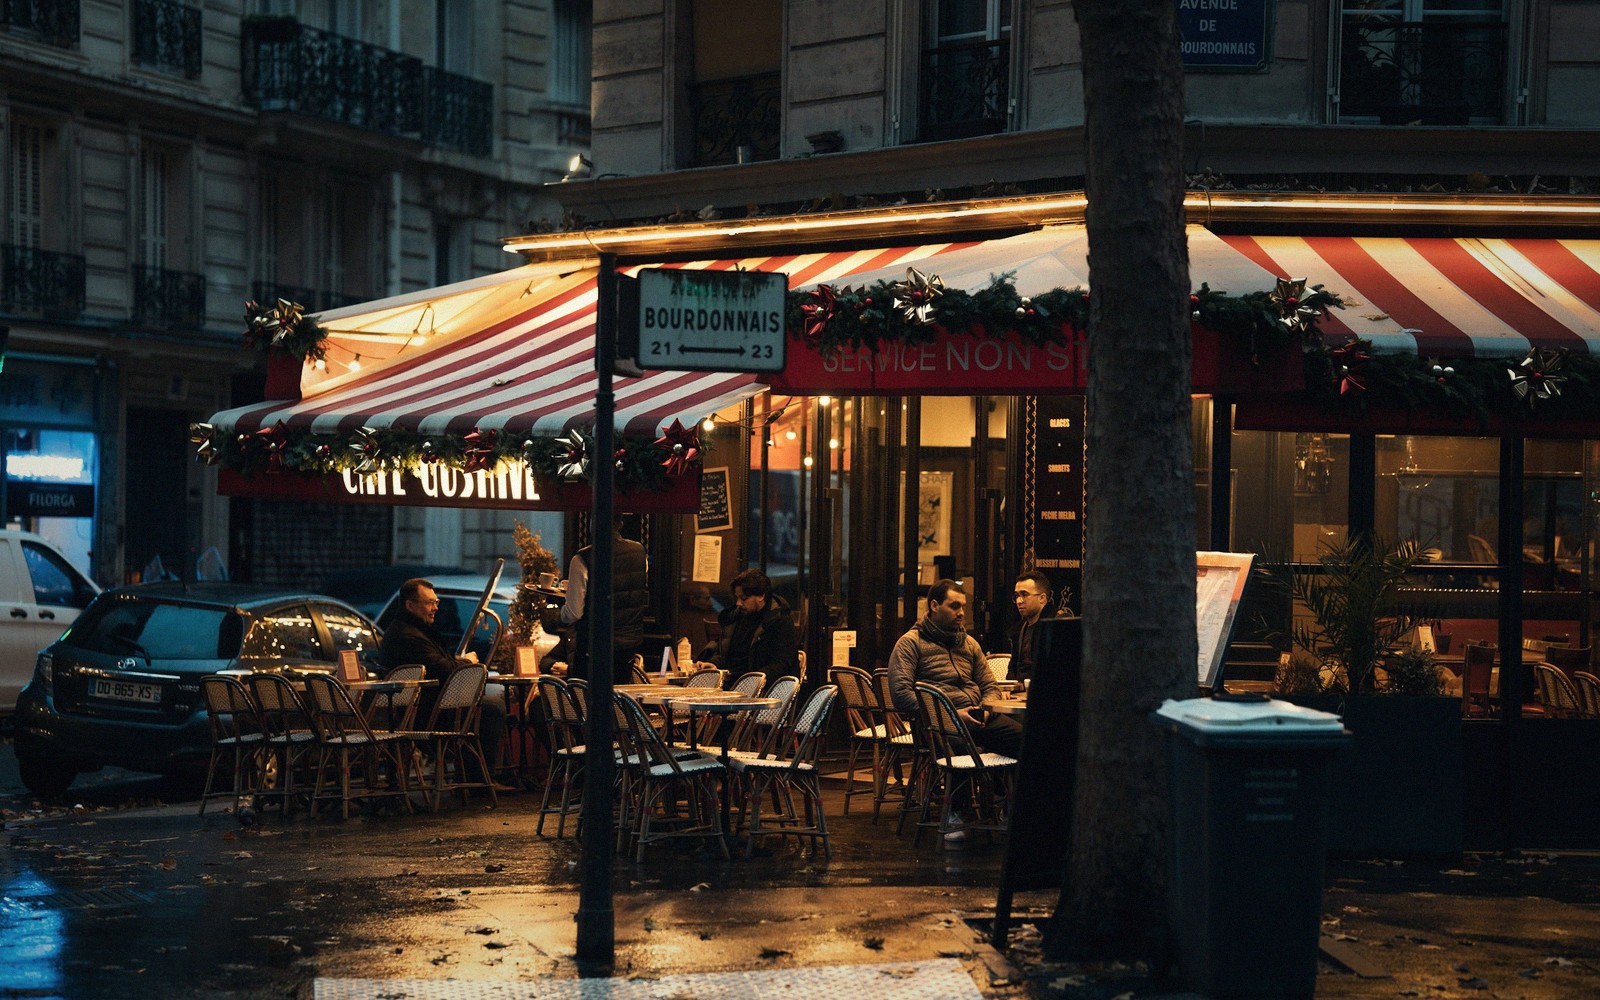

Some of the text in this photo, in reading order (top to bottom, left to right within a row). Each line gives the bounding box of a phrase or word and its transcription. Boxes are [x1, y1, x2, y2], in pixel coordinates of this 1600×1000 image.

[1180, 0, 1238, 10] AVENUE
[1199, 19, 1217, 32] DE
[645, 307, 780, 333] BOURDONNAIS
[651, 342, 774, 359] 21 23
[822, 343, 936, 373] SERVICE
[946, 340, 1031, 371] NON
[29, 492, 76, 508] FILORGA
